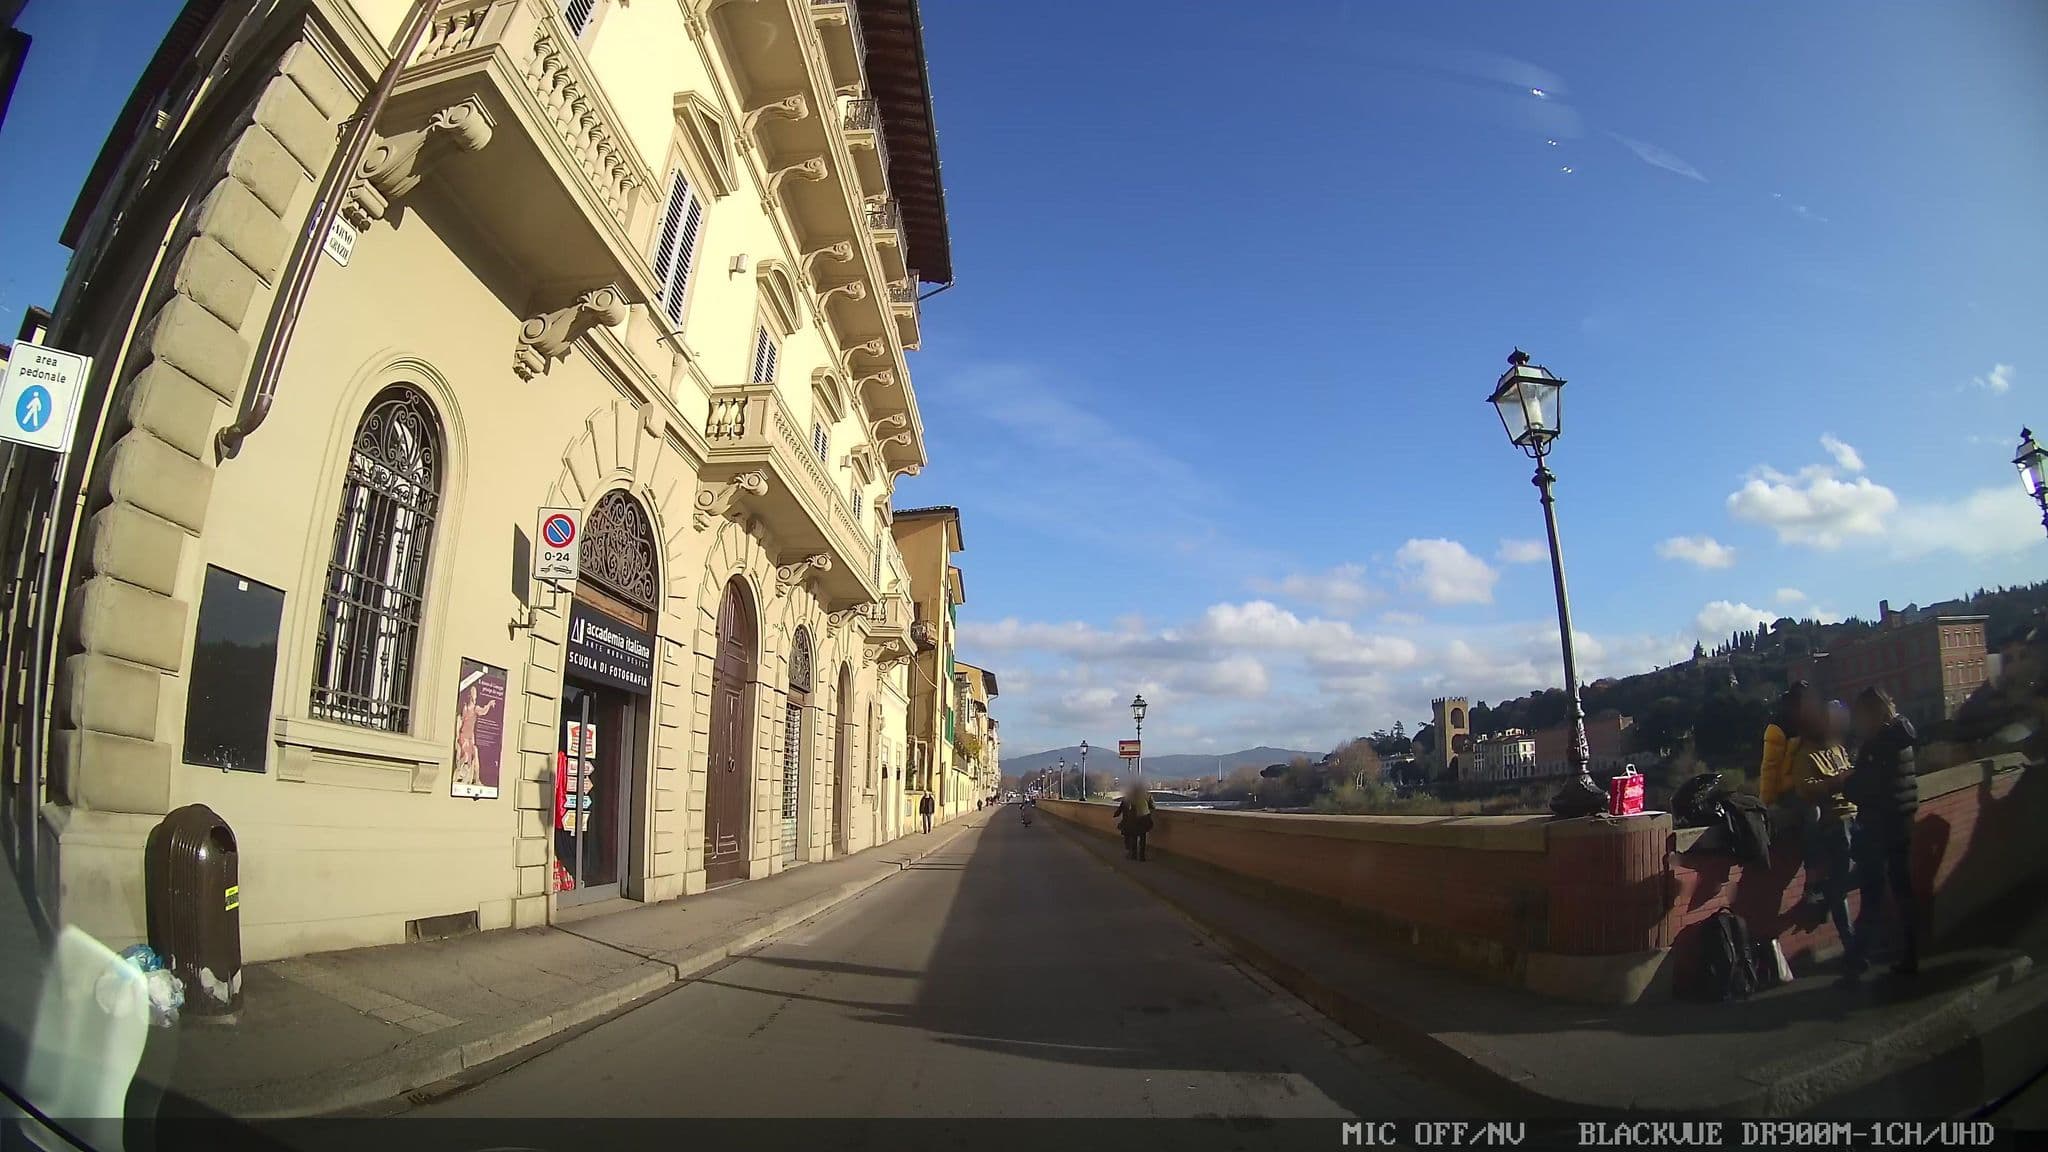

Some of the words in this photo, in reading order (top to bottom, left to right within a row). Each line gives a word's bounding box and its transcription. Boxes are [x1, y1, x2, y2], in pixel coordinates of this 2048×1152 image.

[36, 355, 58, 366] area
[20, 367, 66, 383] pedonale
[545, 552, 570, 561] 0-24
[586, 622, 624, 648] accademia
[625, 636, 650, 658] italiana
[569, 651, 597, 670] SCUOLA
[600, 662, 607, 673] DI
[609, 665, 648, 686] FOTOGRAFIA
